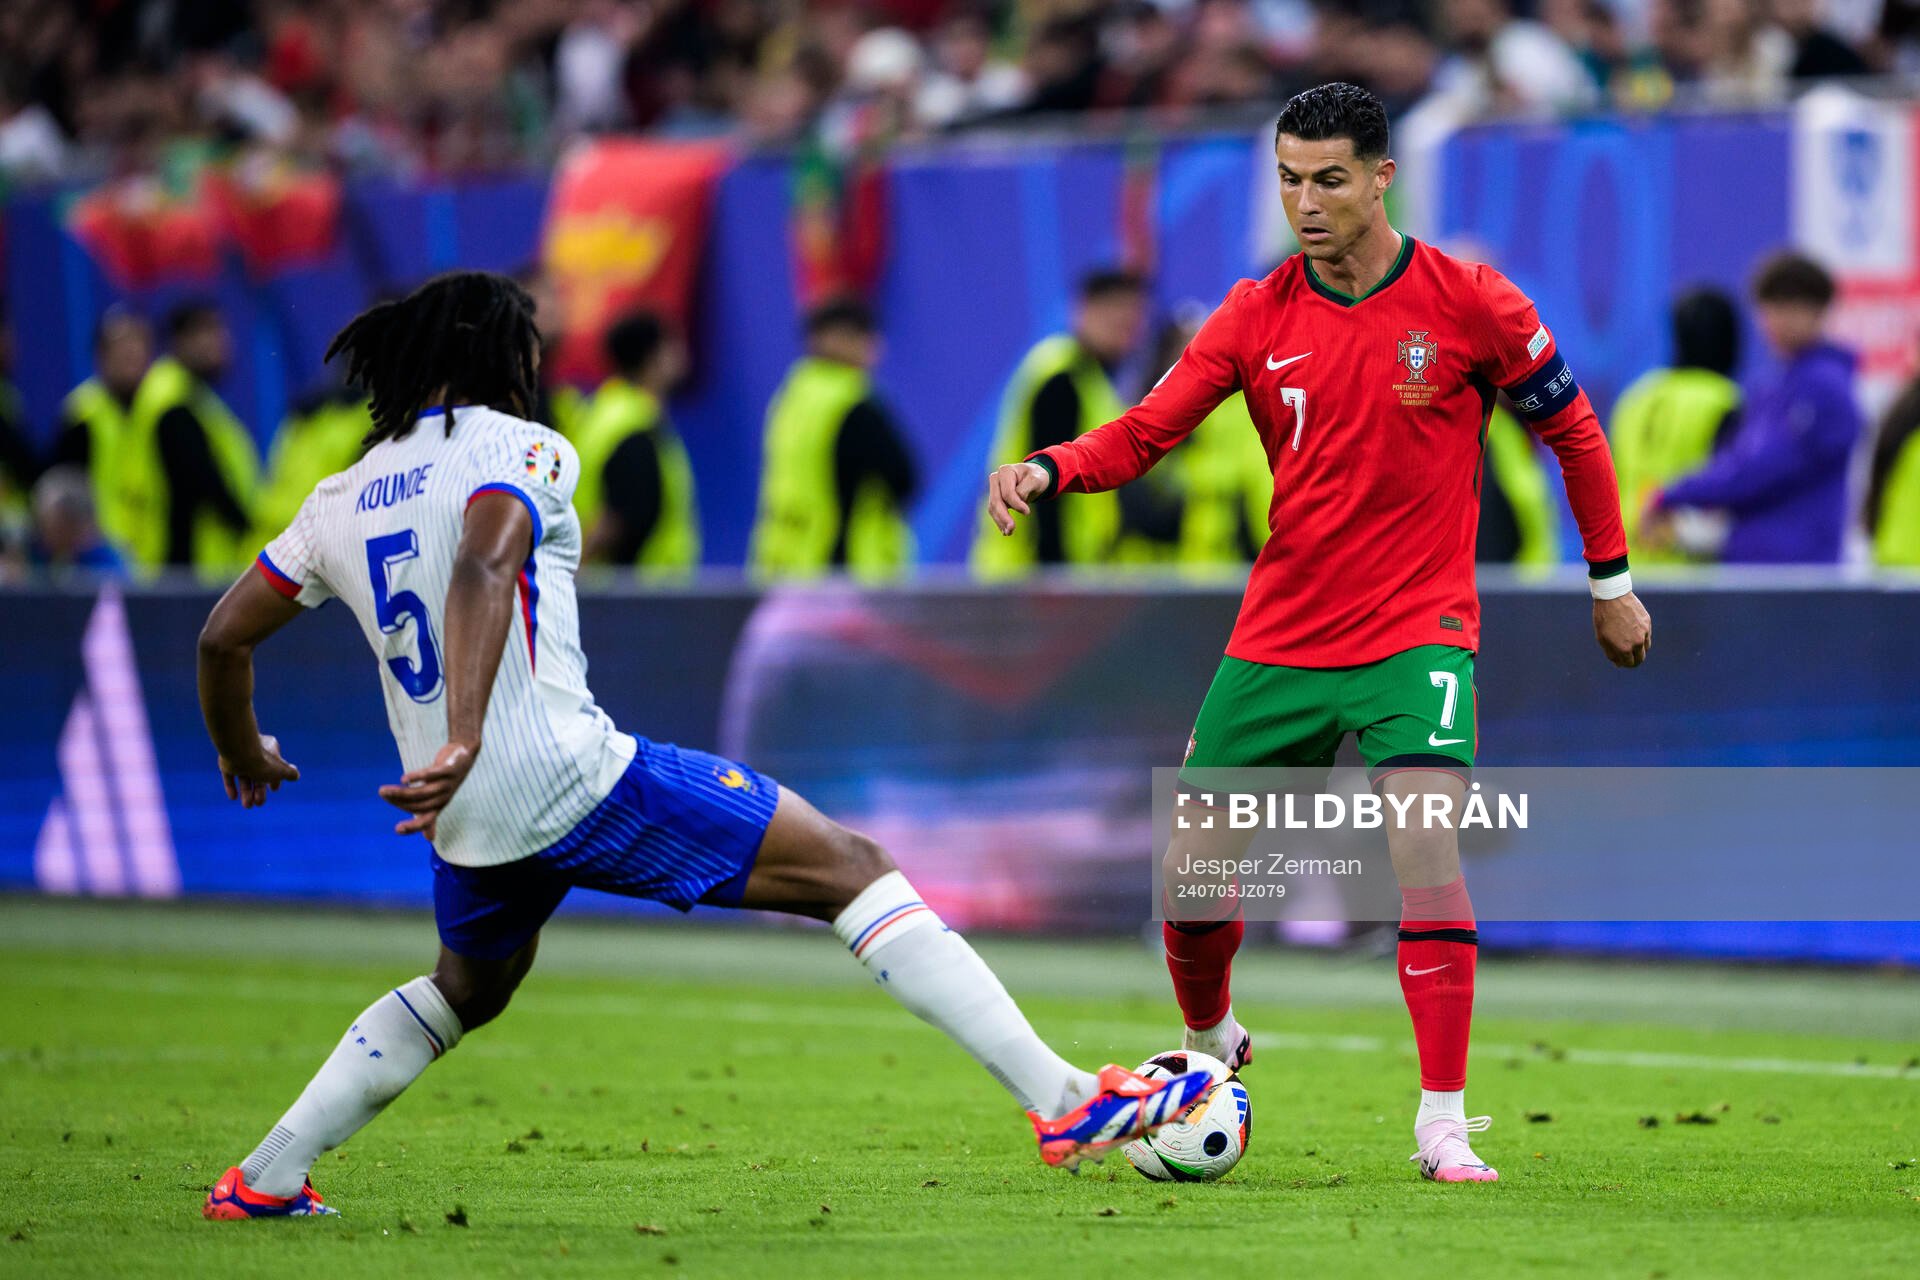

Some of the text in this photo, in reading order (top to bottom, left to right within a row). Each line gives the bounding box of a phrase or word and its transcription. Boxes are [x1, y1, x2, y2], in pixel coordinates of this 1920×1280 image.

[1280, 387, 1306, 451] 7
[355, 463, 434, 514] KOUNDE
[366, 528, 445, 704] 5
[1429, 671, 1459, 730] 7
